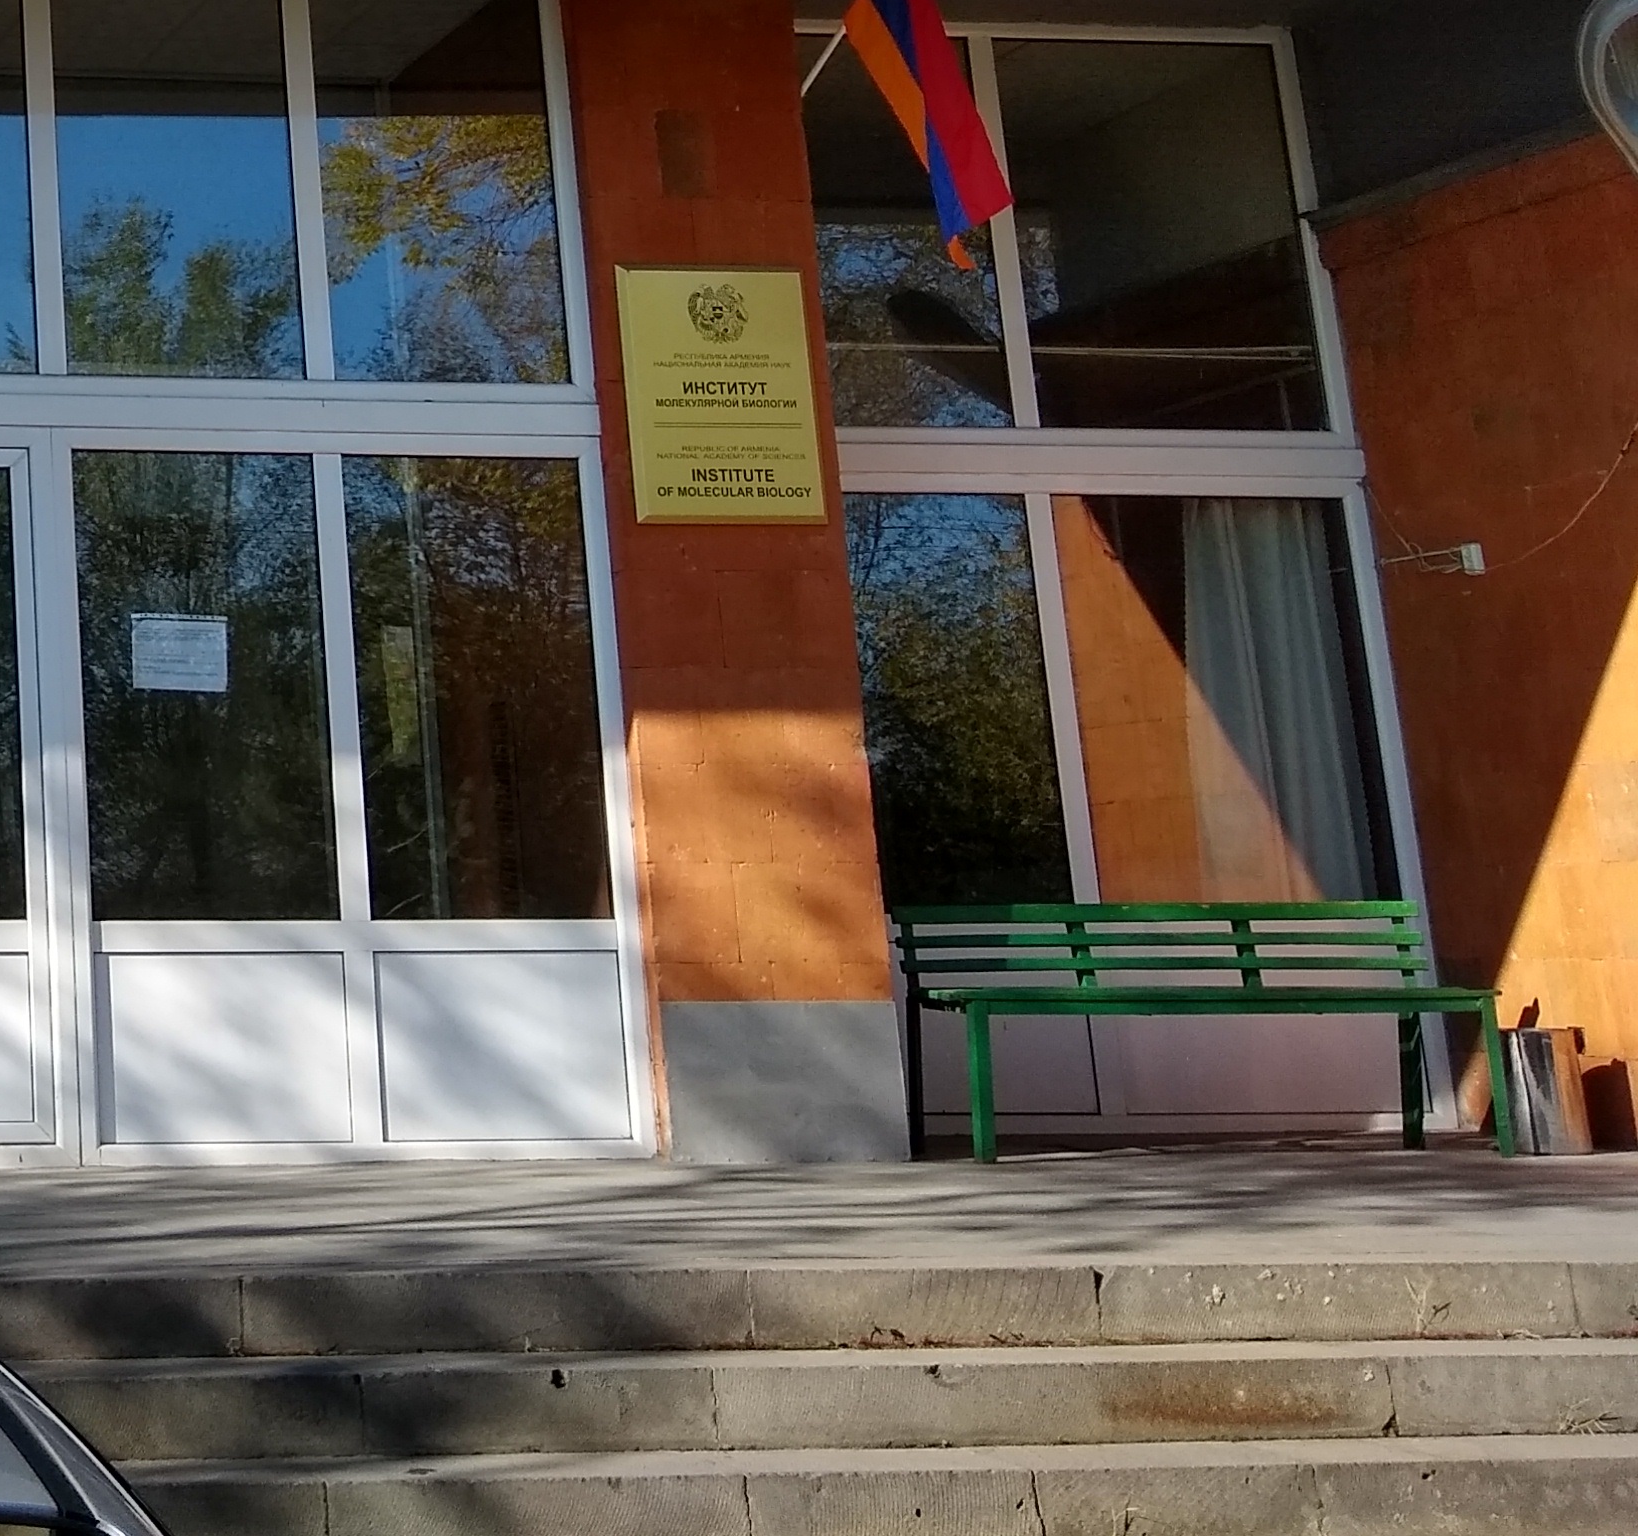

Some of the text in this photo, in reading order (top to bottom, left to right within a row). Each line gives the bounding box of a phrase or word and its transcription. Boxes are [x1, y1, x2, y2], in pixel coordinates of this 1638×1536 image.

[682, 381, 767, 396] ИНСТИТУТ
[655, 397, 797, 409] МОЛЕКУЛЯРНОЙ БИОЛОГИИ
[691, 468, 776, 483] INSTITUTE
[657, 486, 812, 499] OF MOLECULAR BIOLOGY
